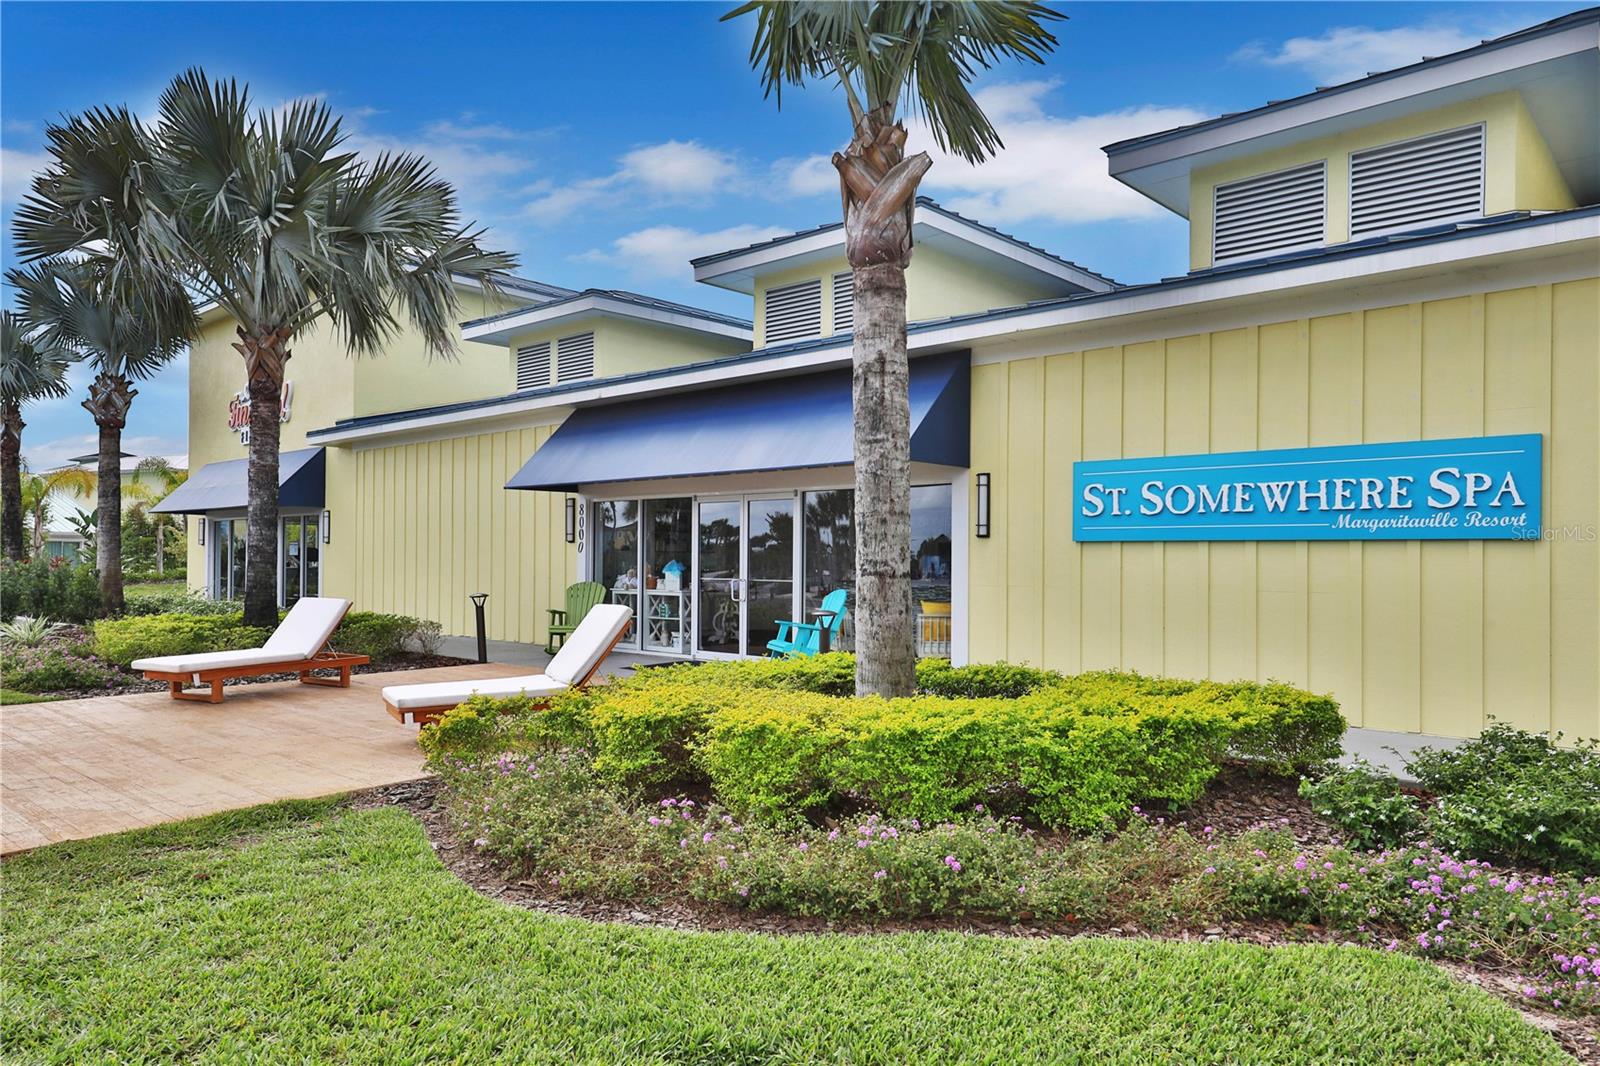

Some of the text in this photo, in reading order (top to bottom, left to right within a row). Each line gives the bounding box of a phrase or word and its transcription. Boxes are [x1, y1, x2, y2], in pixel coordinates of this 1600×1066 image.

[577, 503, 585, 553] 8000
[1331, 511, 1528, 534] Margaritaville Resort
